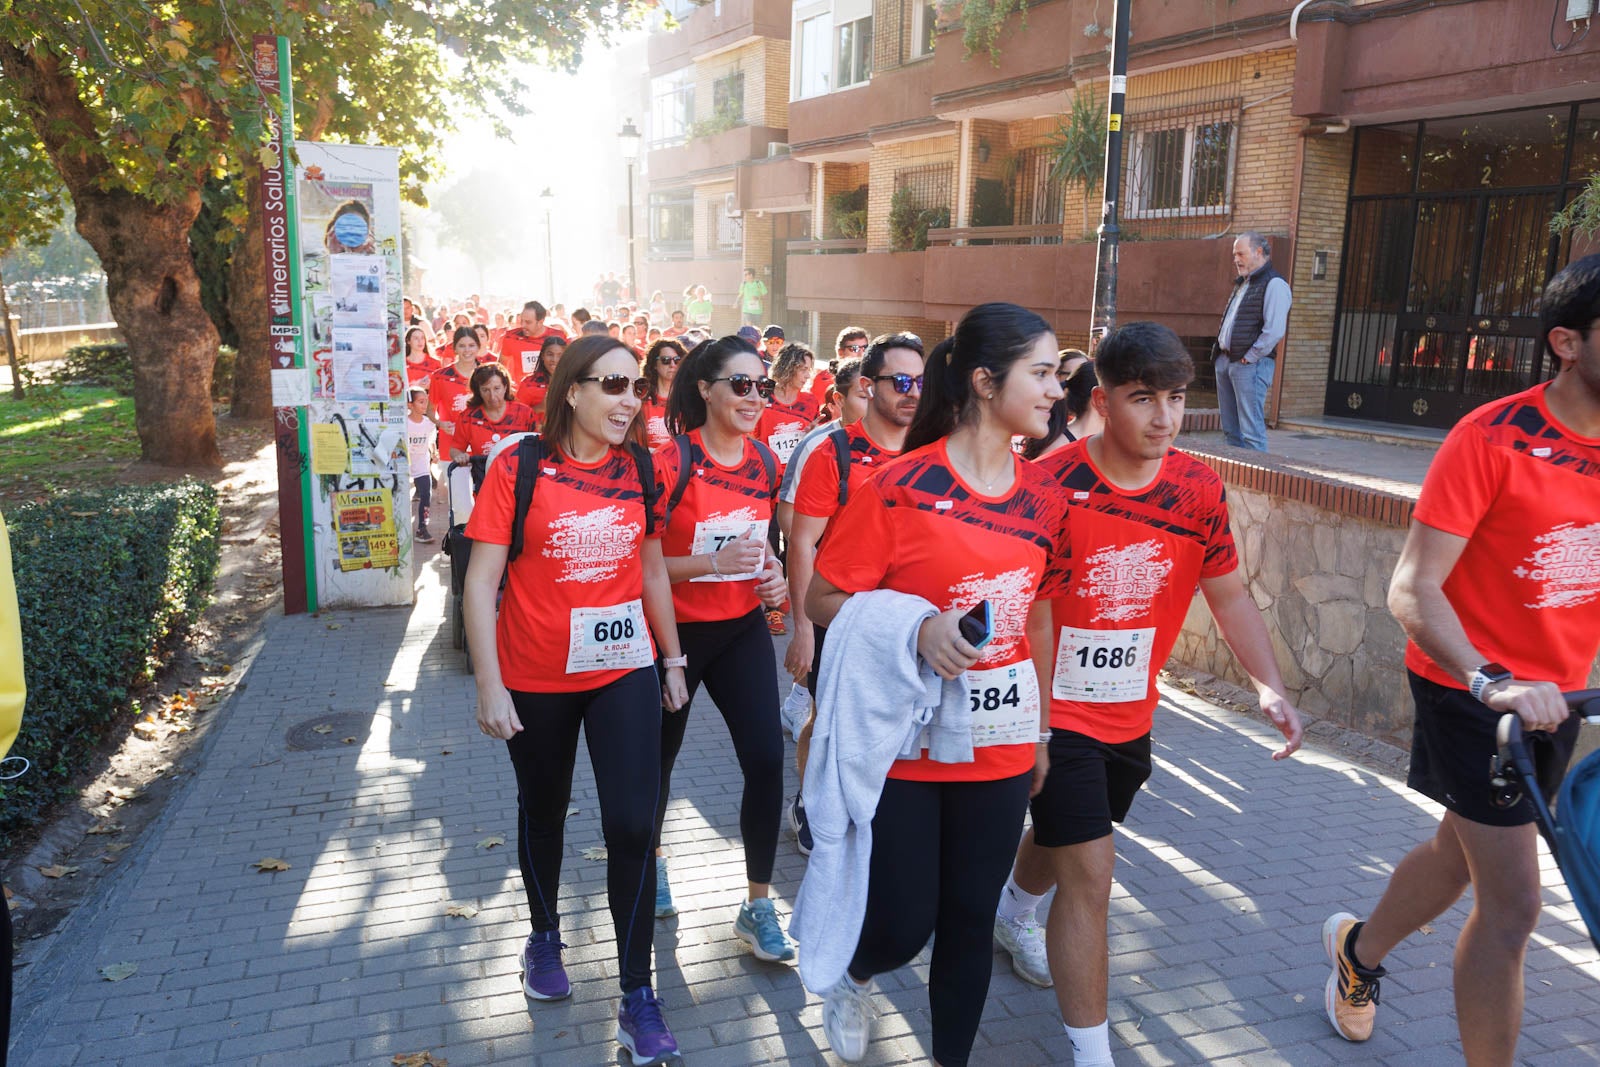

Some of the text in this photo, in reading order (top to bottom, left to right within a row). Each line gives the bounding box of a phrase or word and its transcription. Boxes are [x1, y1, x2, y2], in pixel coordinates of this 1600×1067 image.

[1481, 166, 1492, 184] 2
[272, 327, 300, 335] MPS
[409, 436, 426, 444] 1077
[338, 494, 382, 505] MOLINA
[369, 506, 386, 524] B
[552, 528, 634, 546] carrera
[370, 540, 386, 550] 149
[552, 545, 631, 558] cruzroja.es
[594, 618, 634, 642] 608
[612, 643, 631, 651] ROJAS
[1076, 646, 1137, 669] 1686
